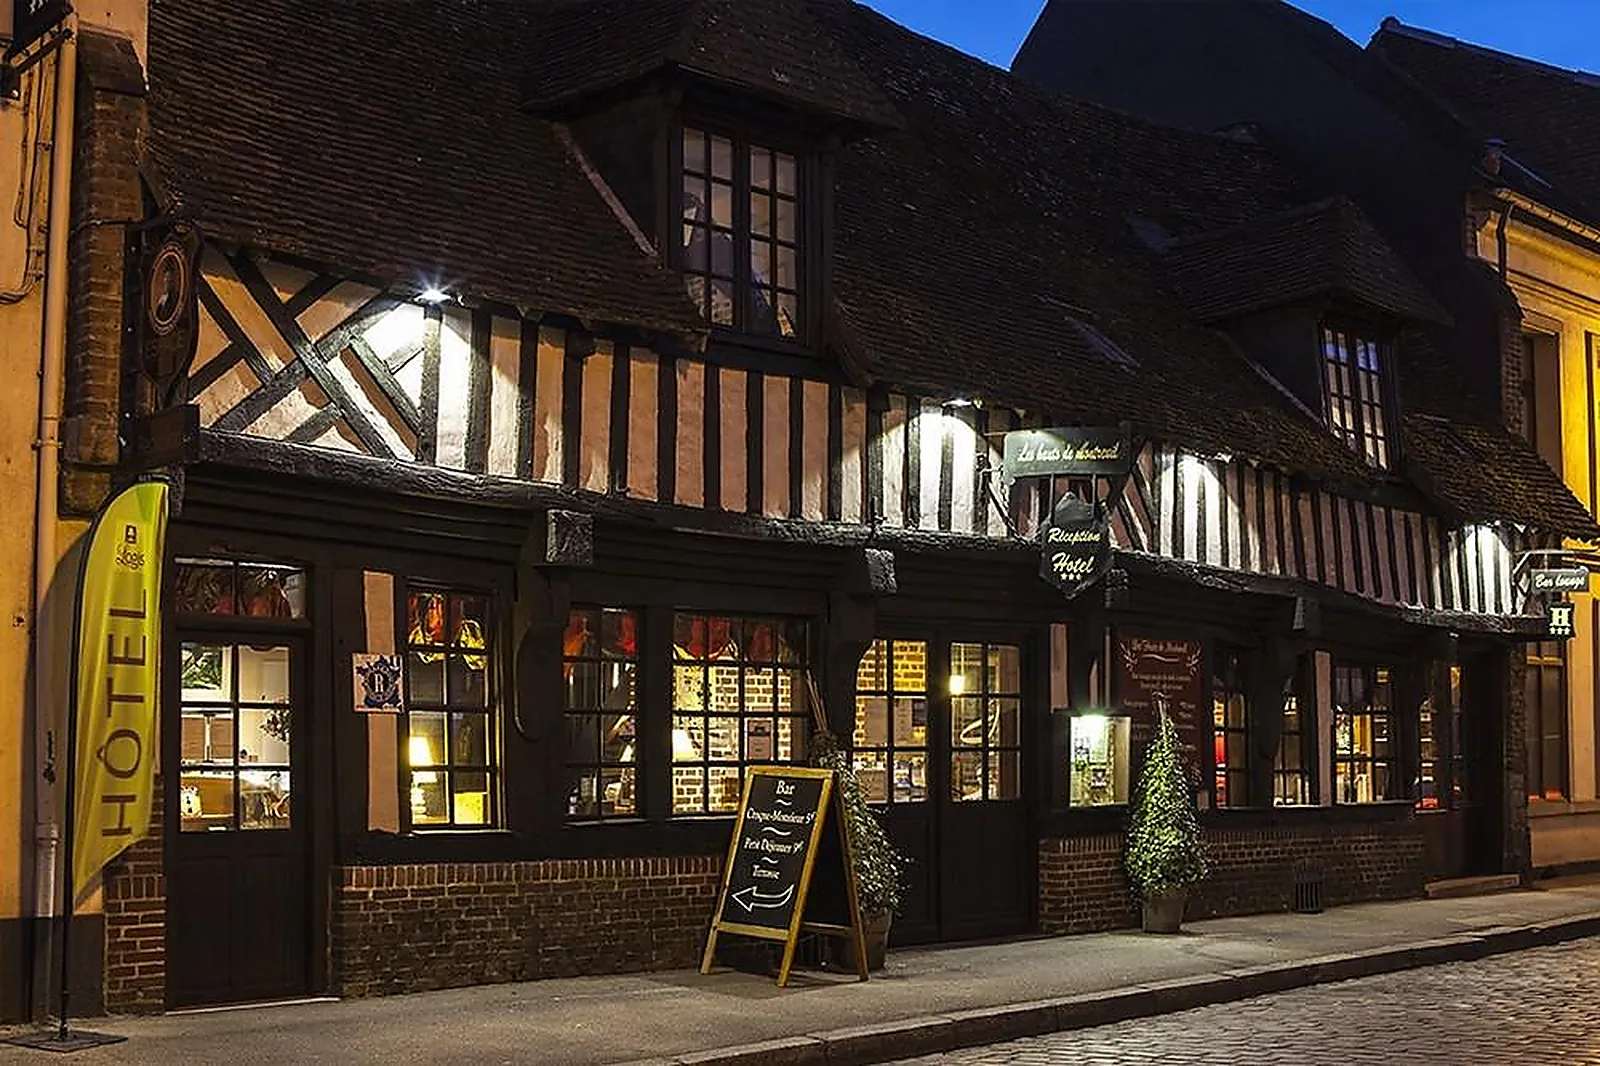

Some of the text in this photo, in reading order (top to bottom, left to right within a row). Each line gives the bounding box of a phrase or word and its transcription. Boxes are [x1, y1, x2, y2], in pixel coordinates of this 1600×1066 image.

[1535, 573, 1553, 588] Bar
[1549, 607, 1571, 627] H
[97, 588, 148, 837] HÔTEL
[776, 780, 796, 795] Bar
